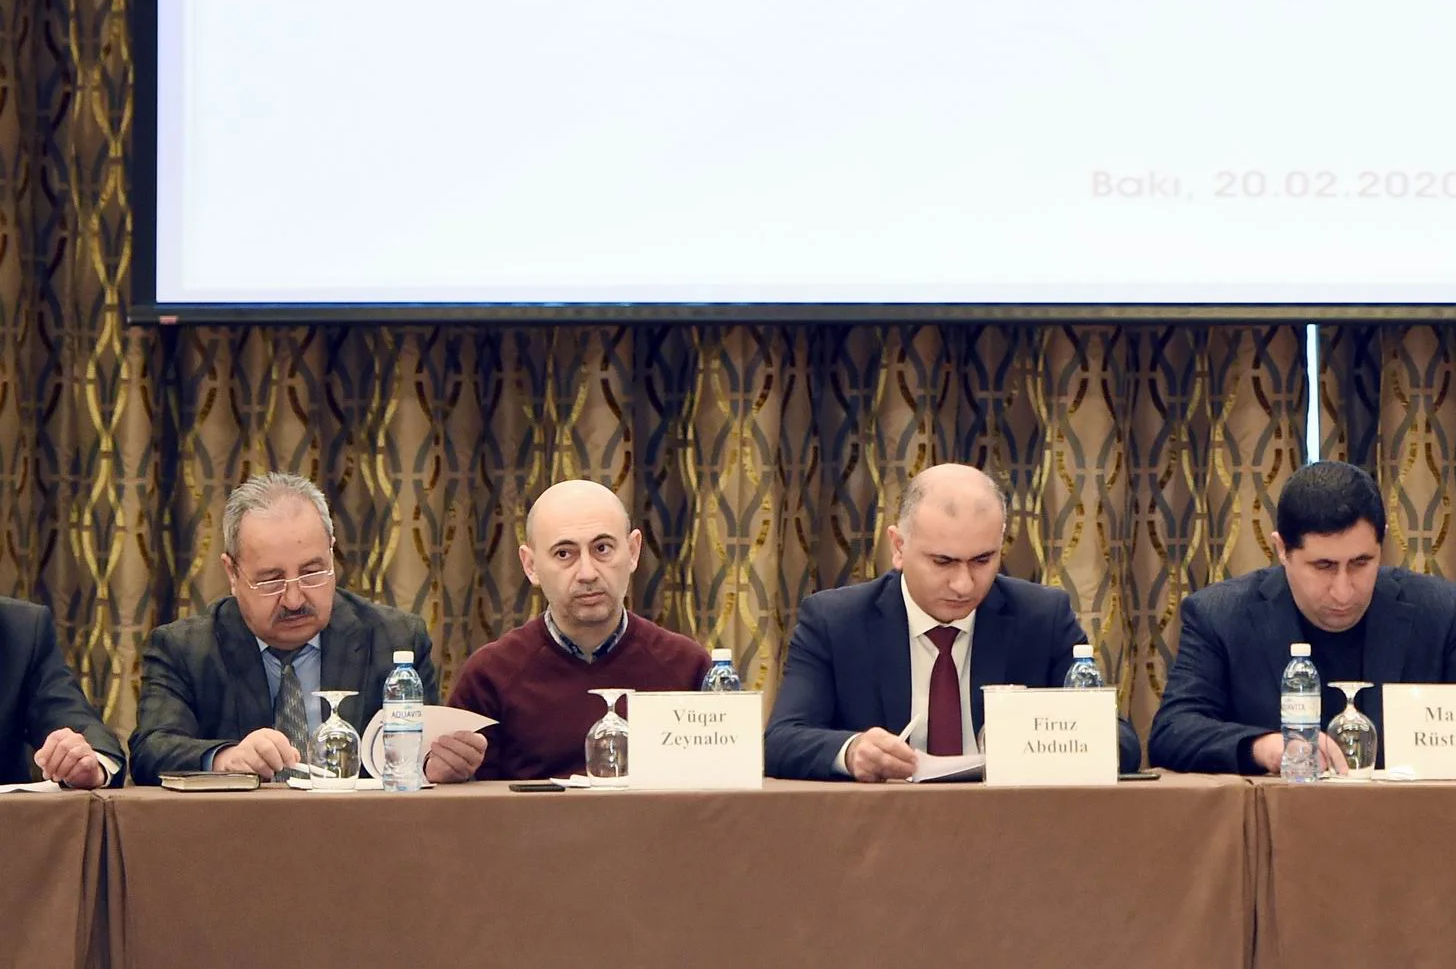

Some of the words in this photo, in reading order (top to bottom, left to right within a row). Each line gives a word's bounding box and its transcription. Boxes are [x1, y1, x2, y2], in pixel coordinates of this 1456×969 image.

[1091, 169, 1194, 201] Bakı,
[673, 709, 727, 726] Vüqar
[1034, 717, 1078, 731] Firuz
[661, 732, 738, 749] Zeynalov
[1024, 740, 1089, 754] Abdulla
